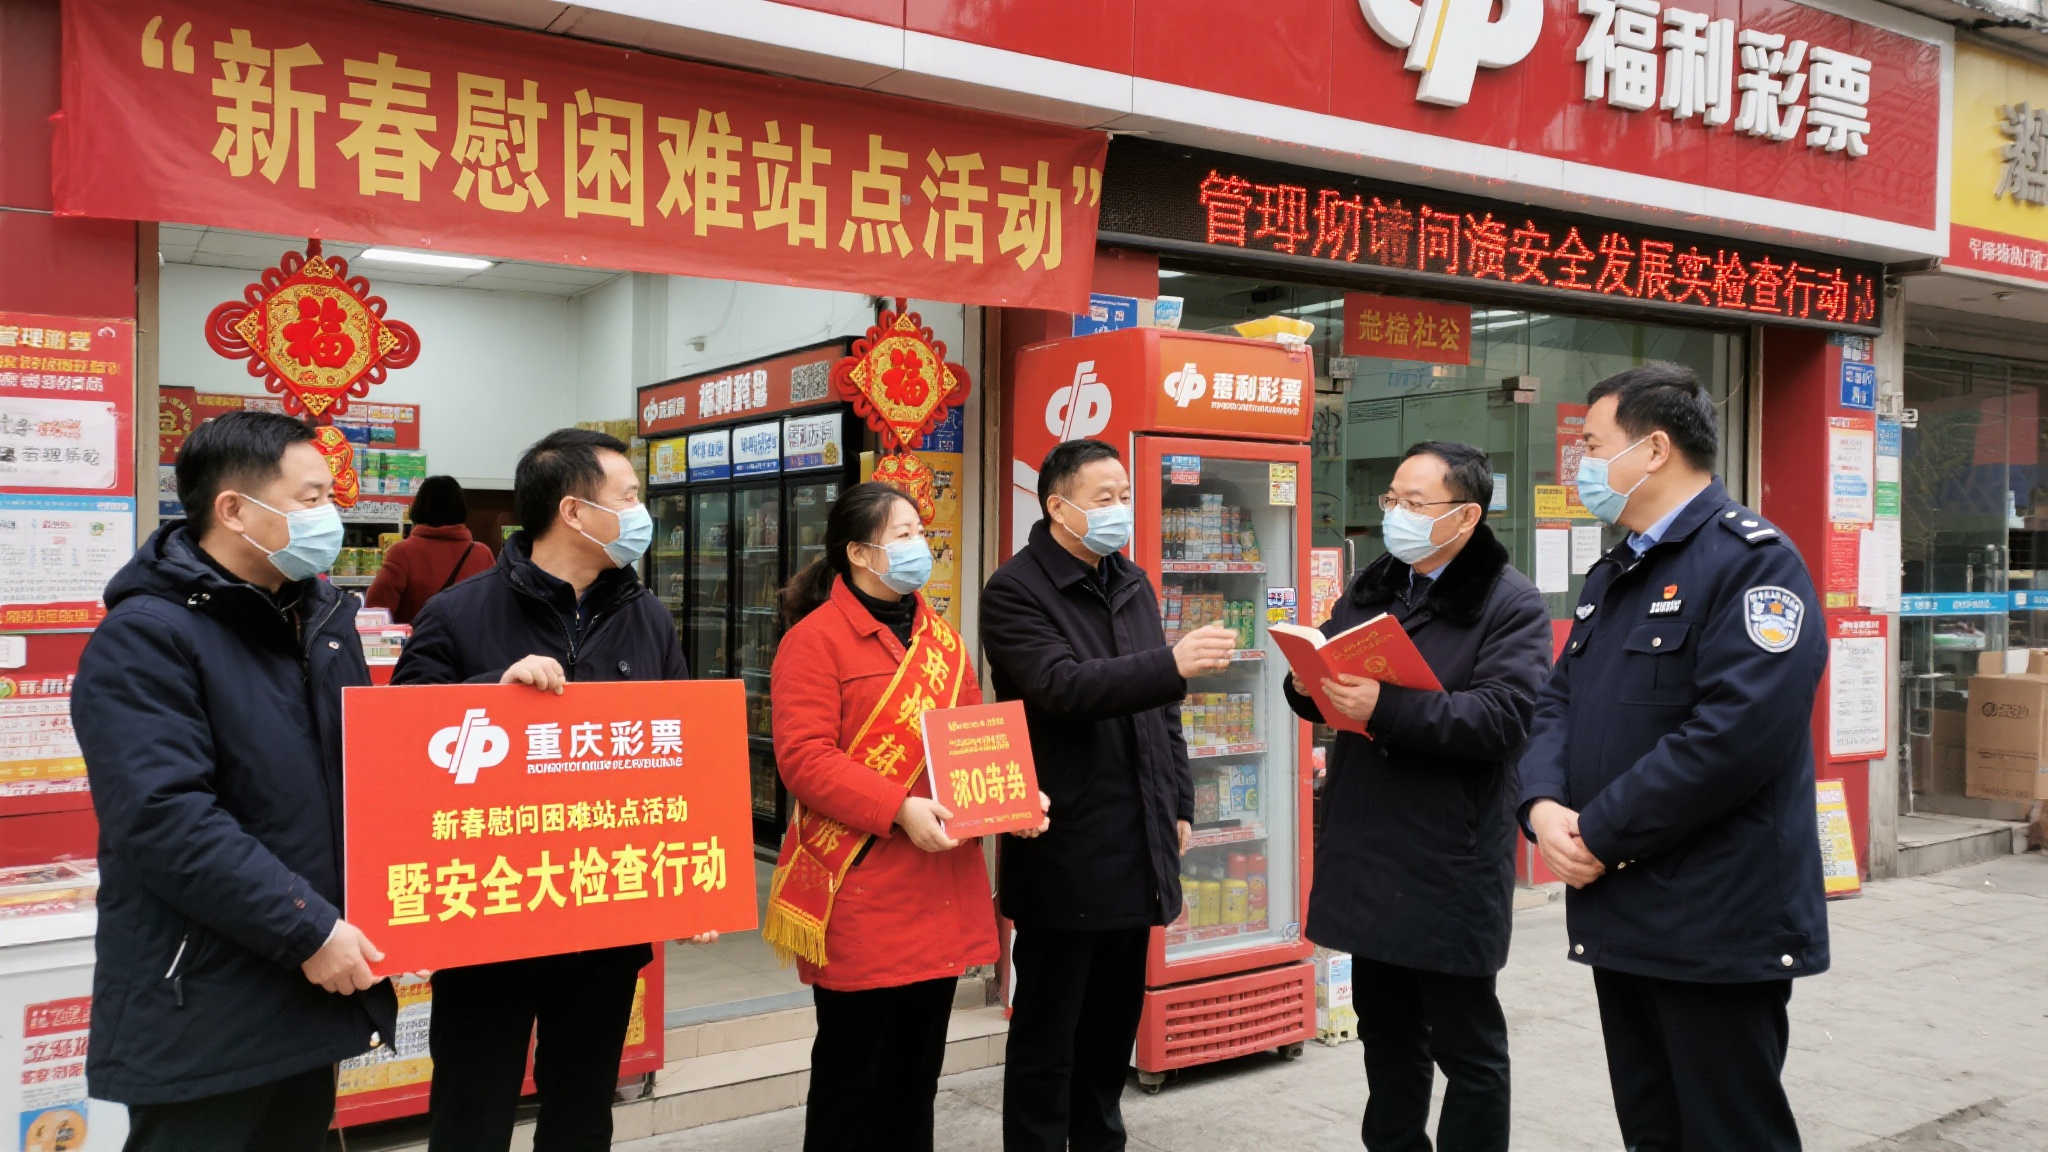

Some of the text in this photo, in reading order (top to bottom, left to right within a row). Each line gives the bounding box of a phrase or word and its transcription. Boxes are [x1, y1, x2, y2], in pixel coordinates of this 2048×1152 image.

[1576, 0, 1873, 157] 福利彩票
[525, 718, 684, 761] 重庆彩票
[431, 795, 688, 841] 新春慰问困难站点活动
[386, 835, 727, 927] 暨安全大检查行动
